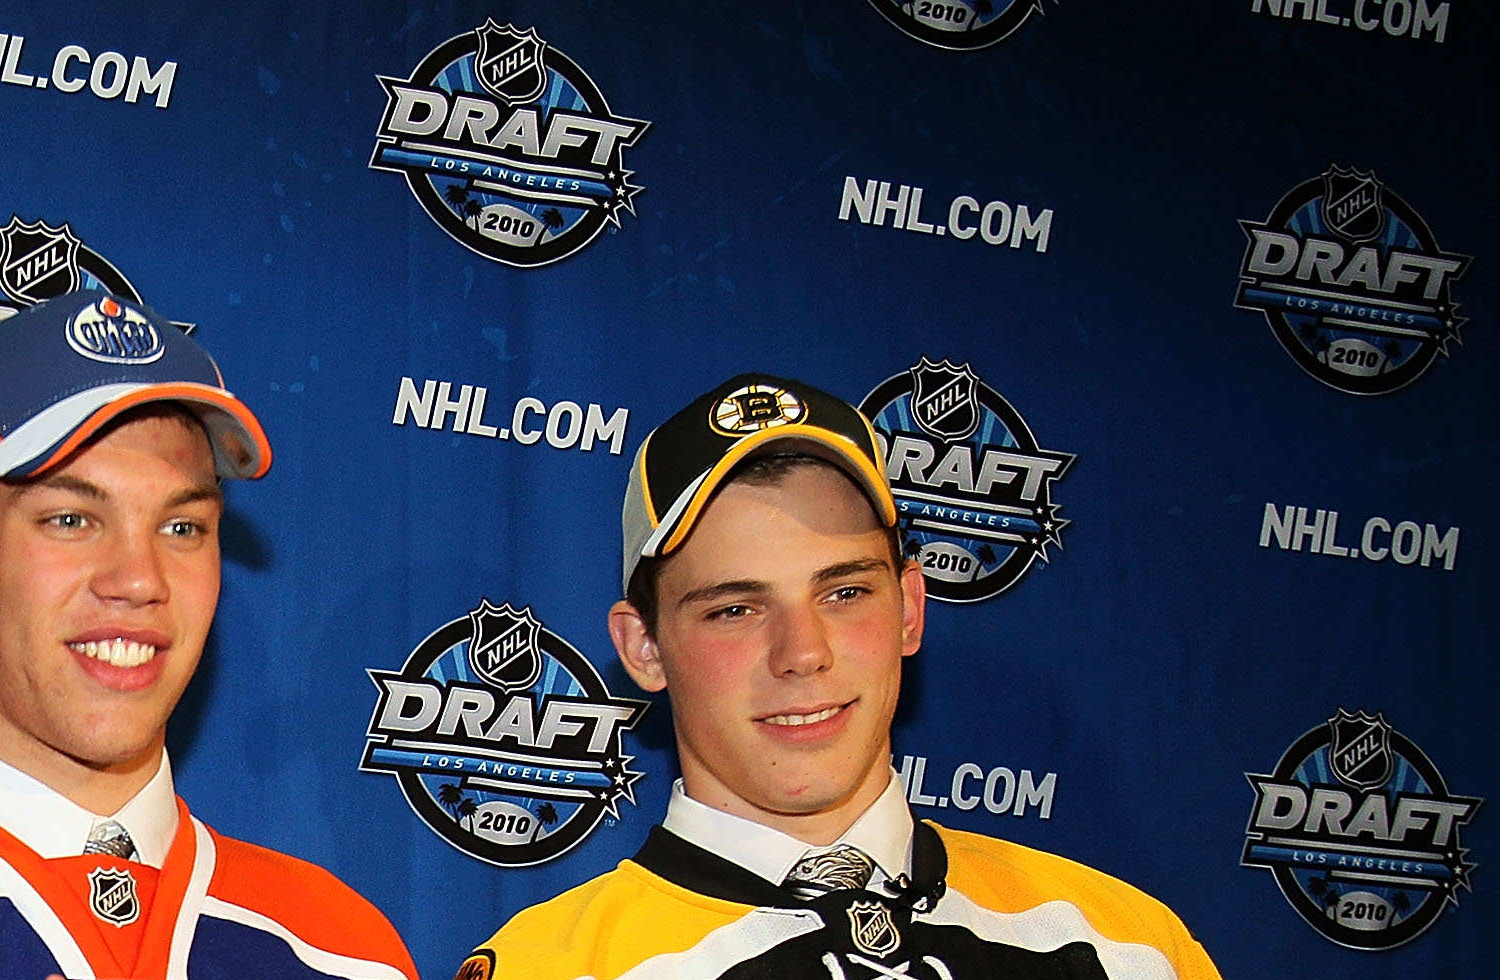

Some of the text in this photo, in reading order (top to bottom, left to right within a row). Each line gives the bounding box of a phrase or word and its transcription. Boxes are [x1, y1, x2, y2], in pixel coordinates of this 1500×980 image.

[917, 1, 967, 24] 2010
[492, 48, 532, 81] NHL
[388, 86, 636, 165] DRAFT
[431, 156, 581, 191] LOS ANGELES
[838, 176, 1053, 253] NHL.COM
[1336, 190, 1371, 222] NHL
[483, 213, 535, 238] 2010
[16, 246, 64, 286] NHL
[1248, 229, 1461, 300] DRAFT
[1286, 296, 1416, 325] LOS ANGELES
[1332, 347, 1378, 368] 2010
[393, 376, 629, 455] NHL.COM
[927, 383, 966, 421] NHL
[922, 505, 1011, 528] ANGELES
[1259, 503, 1459, 570] NHL.COM
[923, 551, 971, 574] 2010
[487, 629, 527, 668] NHL
[378, 680, 636, 752] DRAFT
[1344, 734, 1379, 769] NHL
[423, 755, 575, 783] LOS ANGELES
[478, 811, 530, 835] 2010
[1255, 782, 1471, 846] DRAFT
[1293, 851, 1424, 873] LOS ANGELES
[104, 885, 132, 911] NHL
[1341, 900, 1386, 921] 2010
[863, 915, 886, 945] NHL
